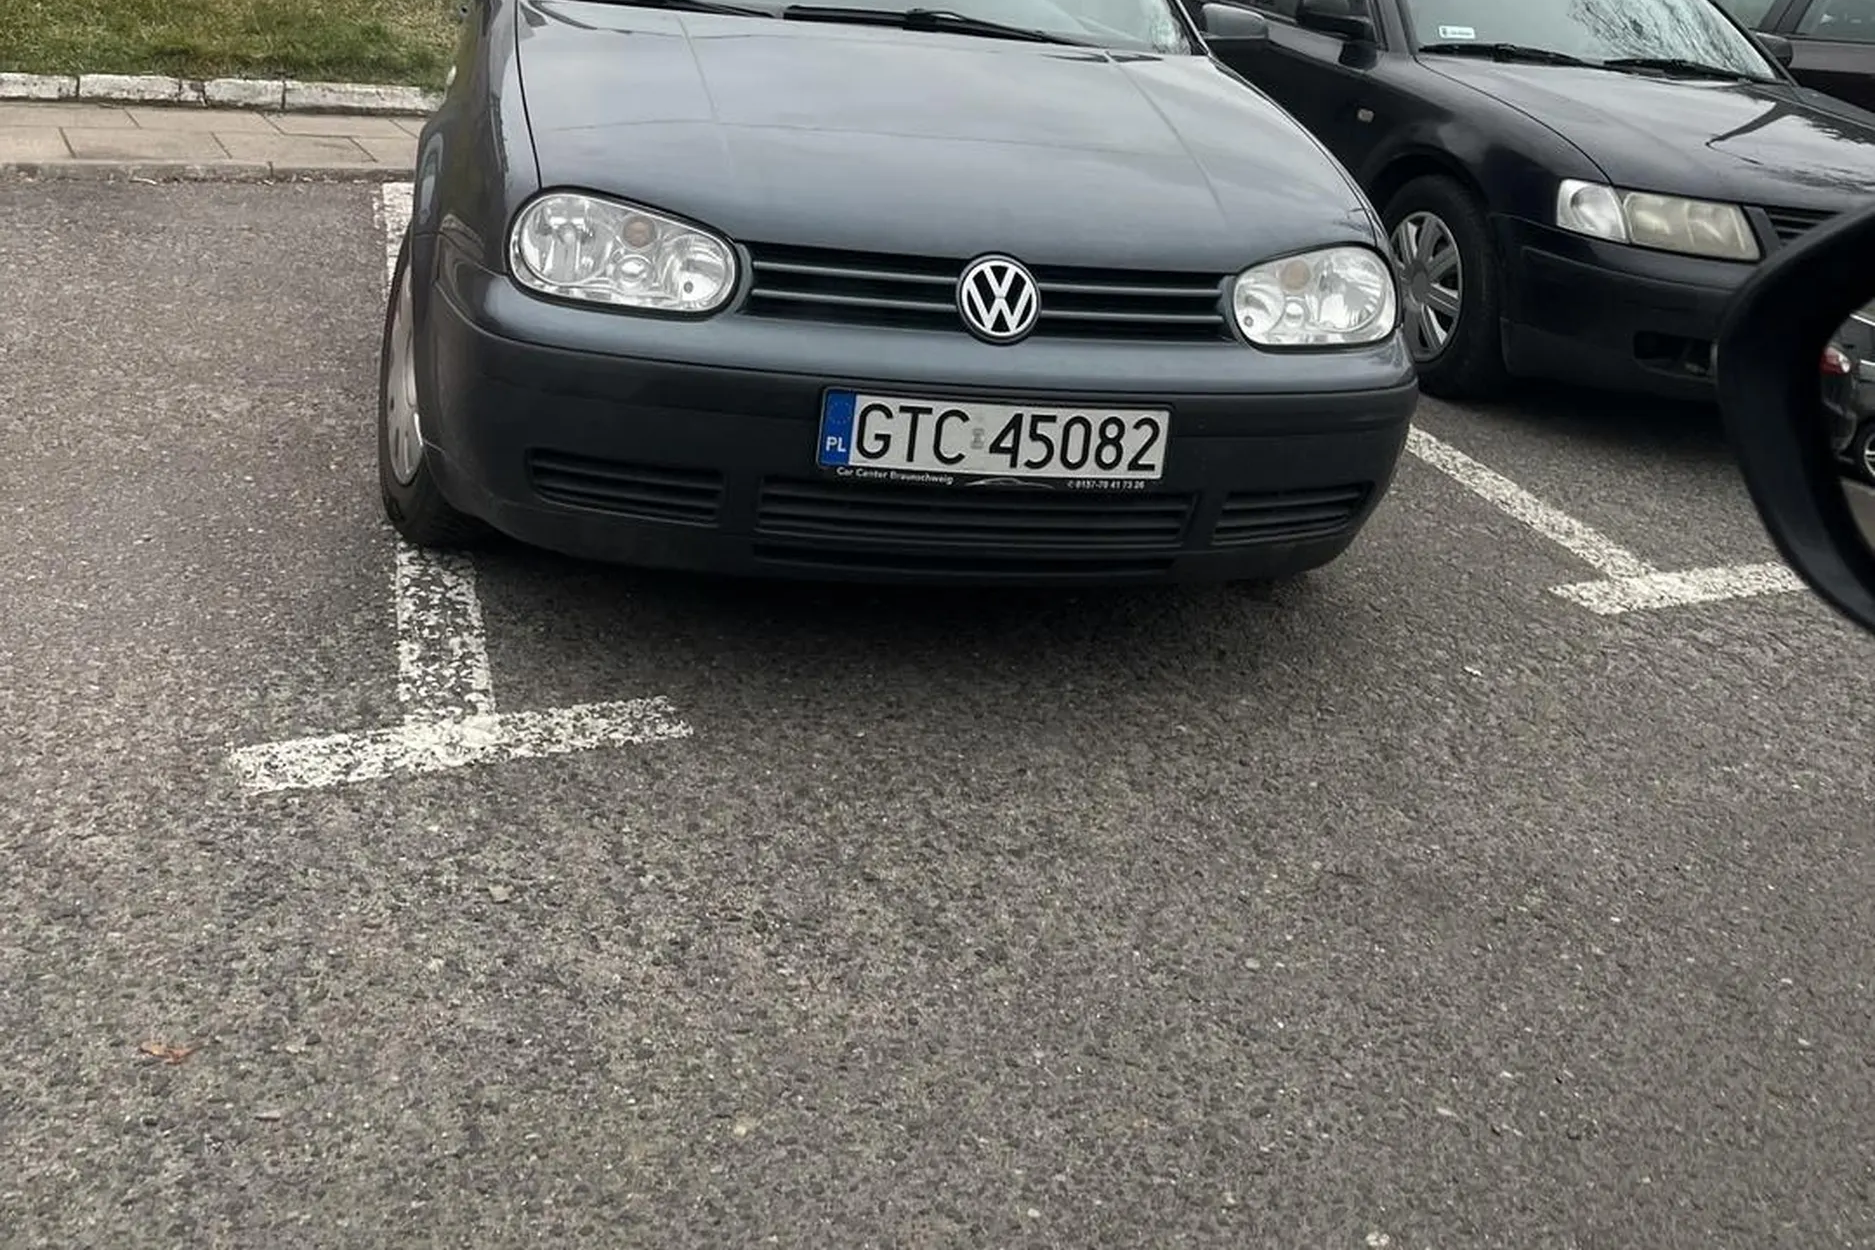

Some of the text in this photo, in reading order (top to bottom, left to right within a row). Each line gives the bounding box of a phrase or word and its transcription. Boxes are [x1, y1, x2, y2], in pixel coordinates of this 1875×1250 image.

[962, 260, 1037, 337] VW
[826, 436, 846, 453] PL
[856, 403, 1160, 471] GTC 45082
